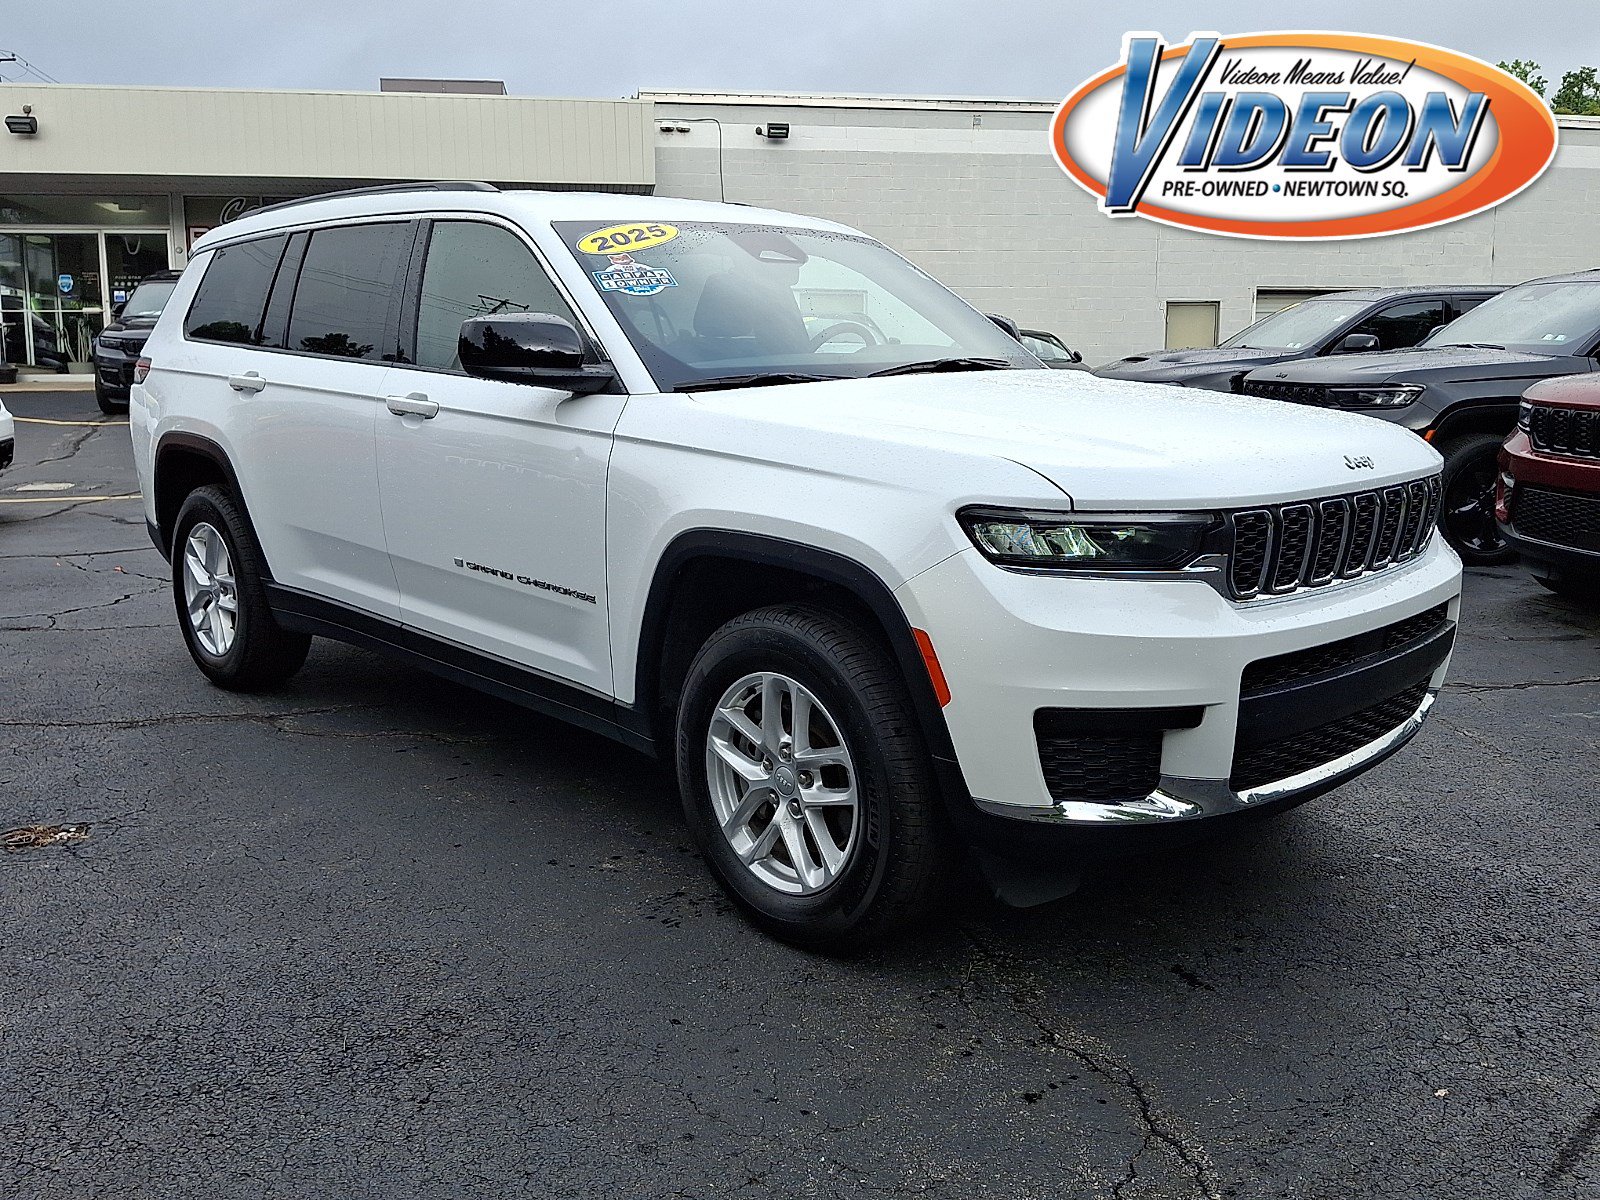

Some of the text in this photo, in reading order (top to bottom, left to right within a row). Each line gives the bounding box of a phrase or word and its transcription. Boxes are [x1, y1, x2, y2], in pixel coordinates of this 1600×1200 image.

[590, 225, 667, 252] 2025
[600, 270, 668, 281] CARFAX
[615, 277, 672, 288] OWNER
[1343, 455, 1375, 470] Jeep
[465, 561, 597, 604] GRAND CHEROKEE
